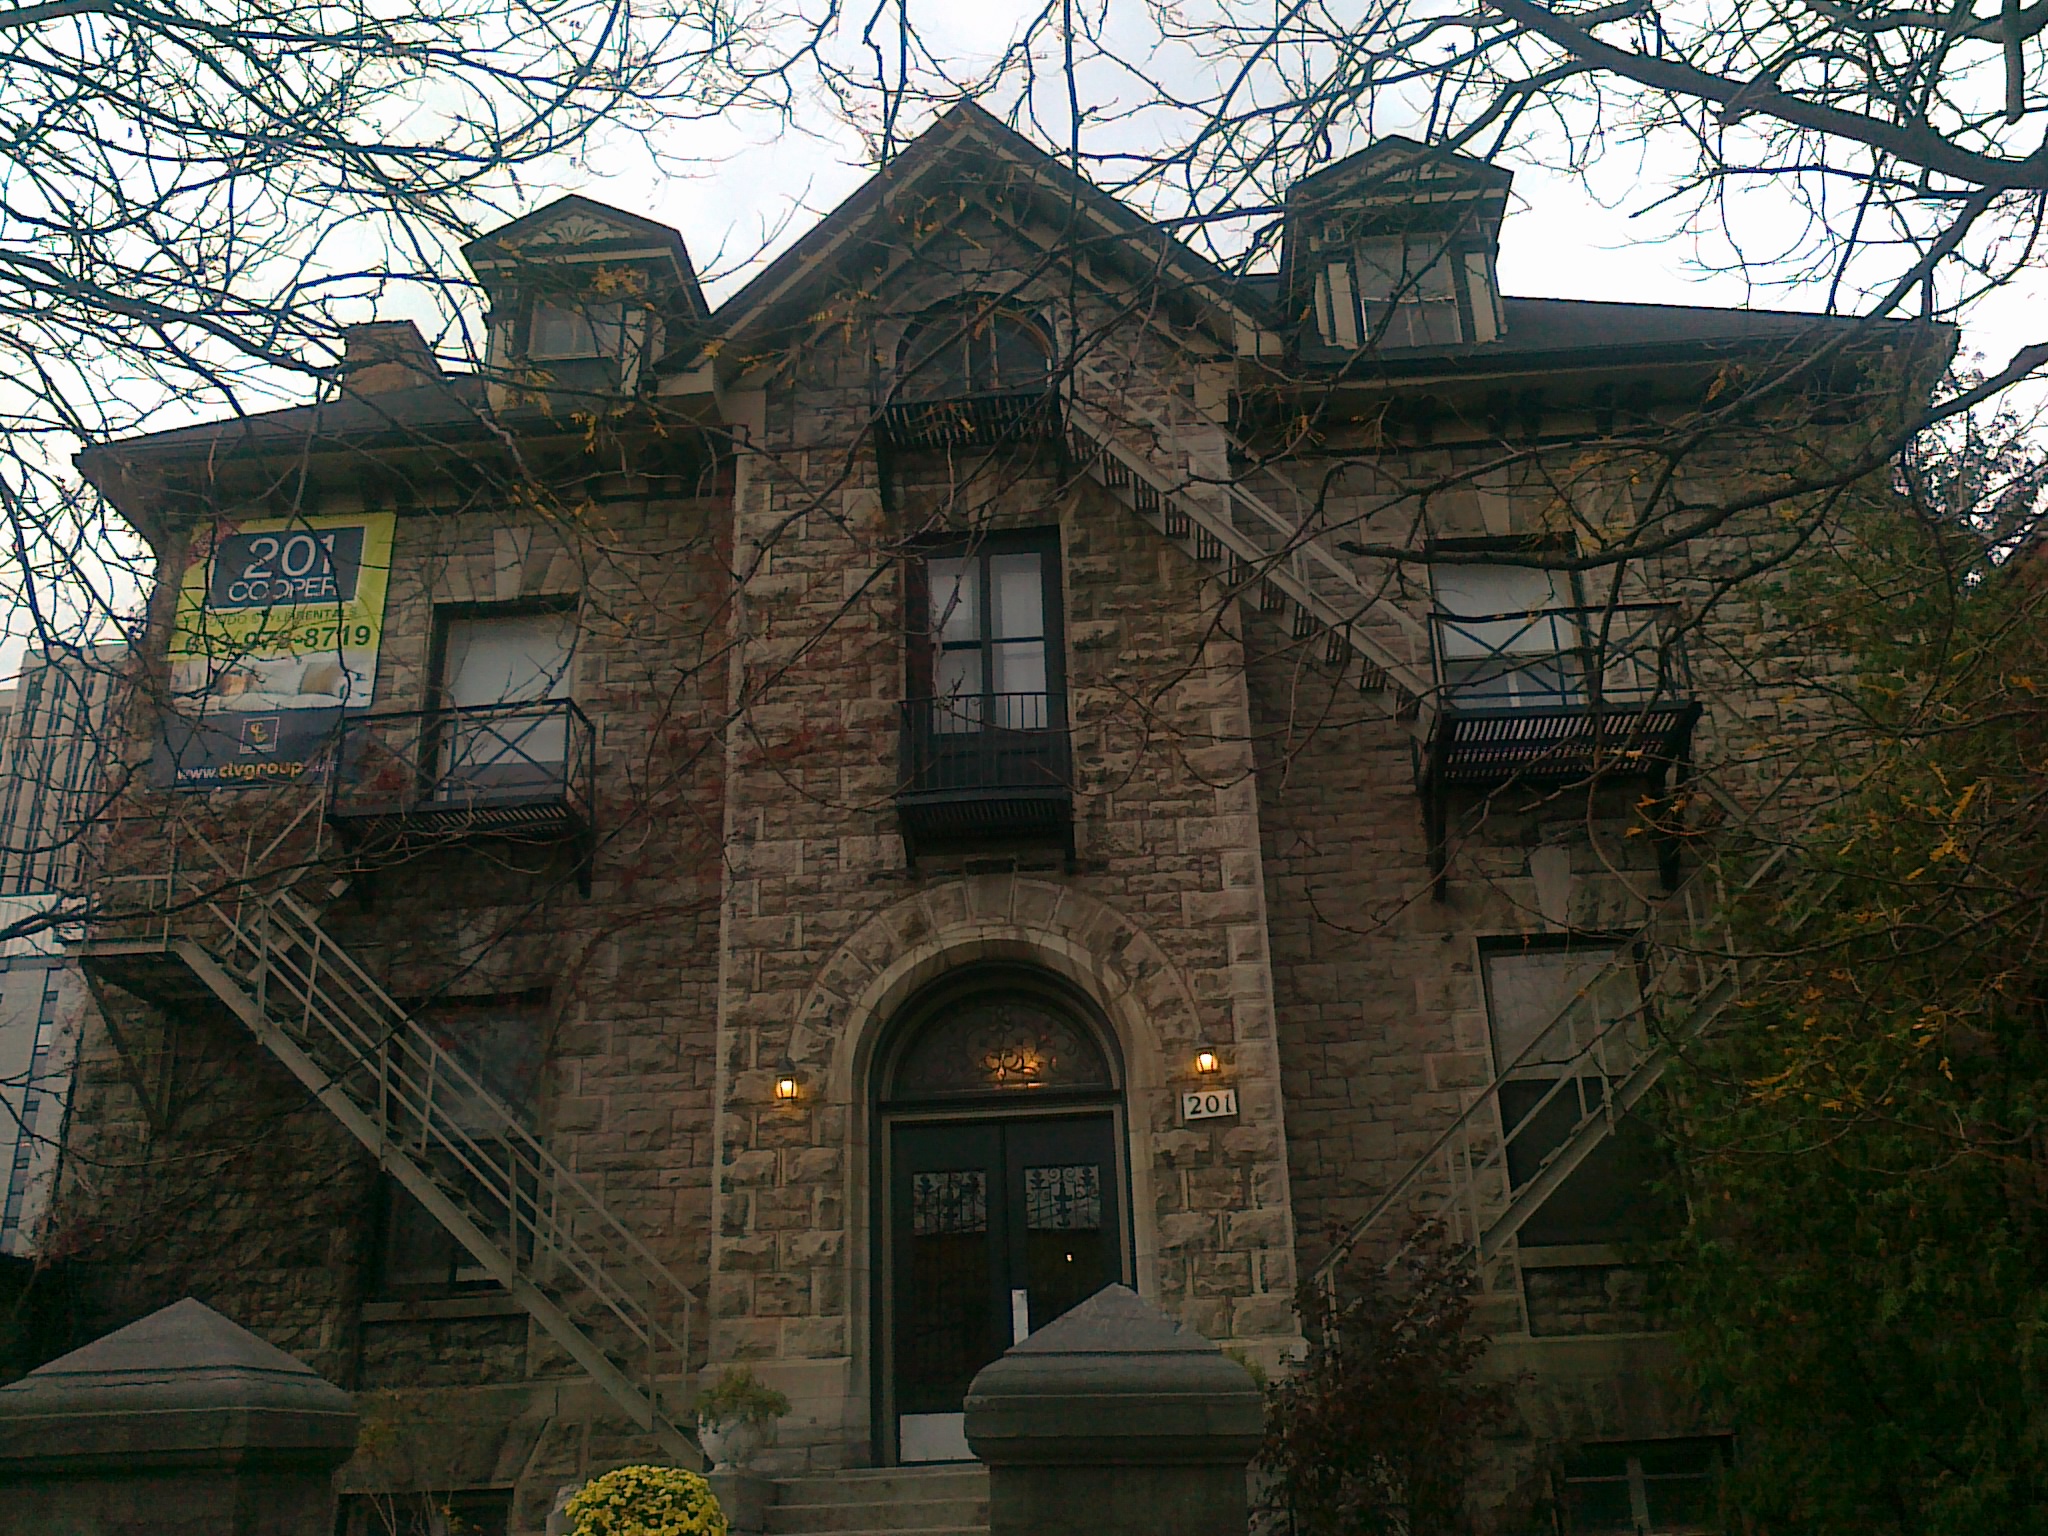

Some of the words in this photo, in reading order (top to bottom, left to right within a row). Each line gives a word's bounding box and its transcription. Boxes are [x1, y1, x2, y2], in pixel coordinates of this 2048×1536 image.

[244, 534, 335, 578] 201
[228, 577, 337, 601] COOPER
[185, 625, 371, 651] 63-978-8719
[176, 762, 336, 781] www.clvgroup
[1188, 1094, 1232, 1115] 201
